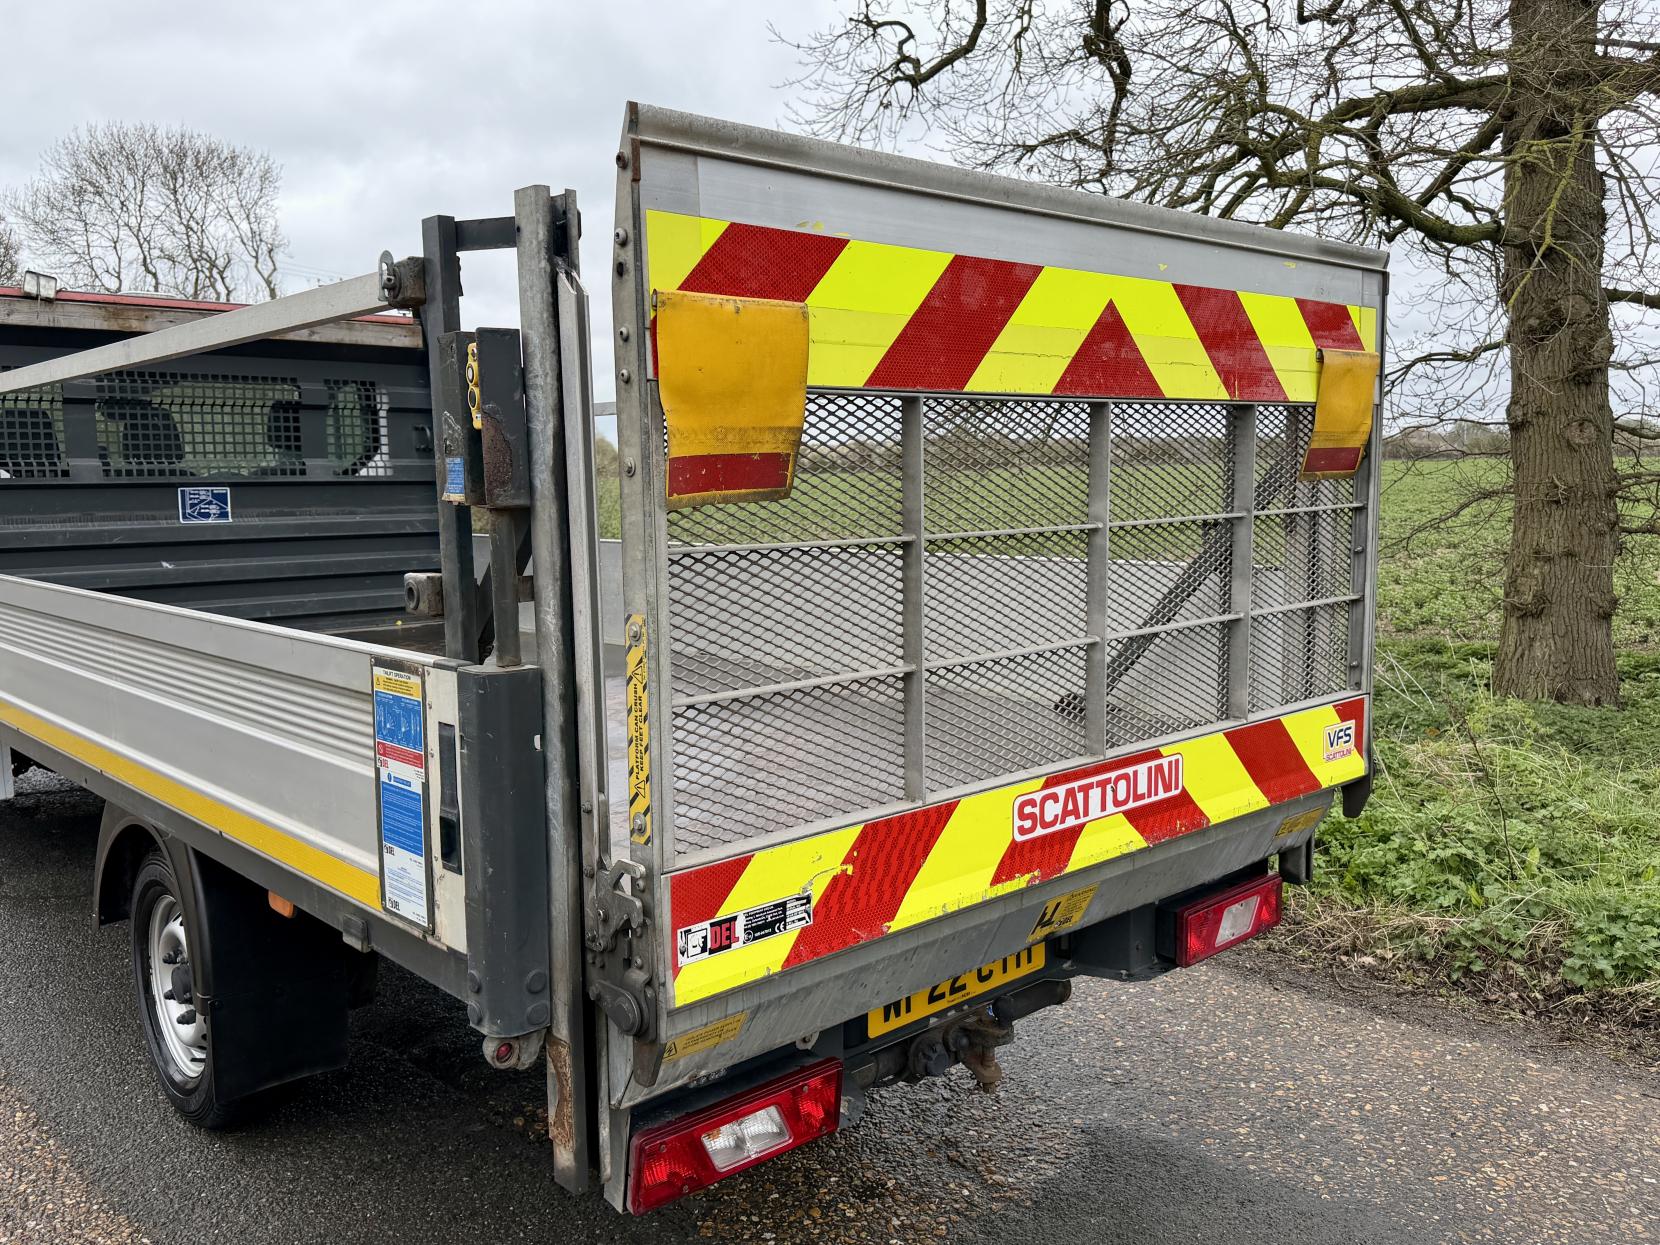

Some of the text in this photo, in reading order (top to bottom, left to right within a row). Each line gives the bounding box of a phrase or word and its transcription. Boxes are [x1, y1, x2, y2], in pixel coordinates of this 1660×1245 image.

[1327, 726, 1352, 748] VFS
[1325, 747, 1352, 761] SCATTOLINI
[1017, 757, 1180, 836] SCATTOLINI
[710, 920, 740, 950] DEL
